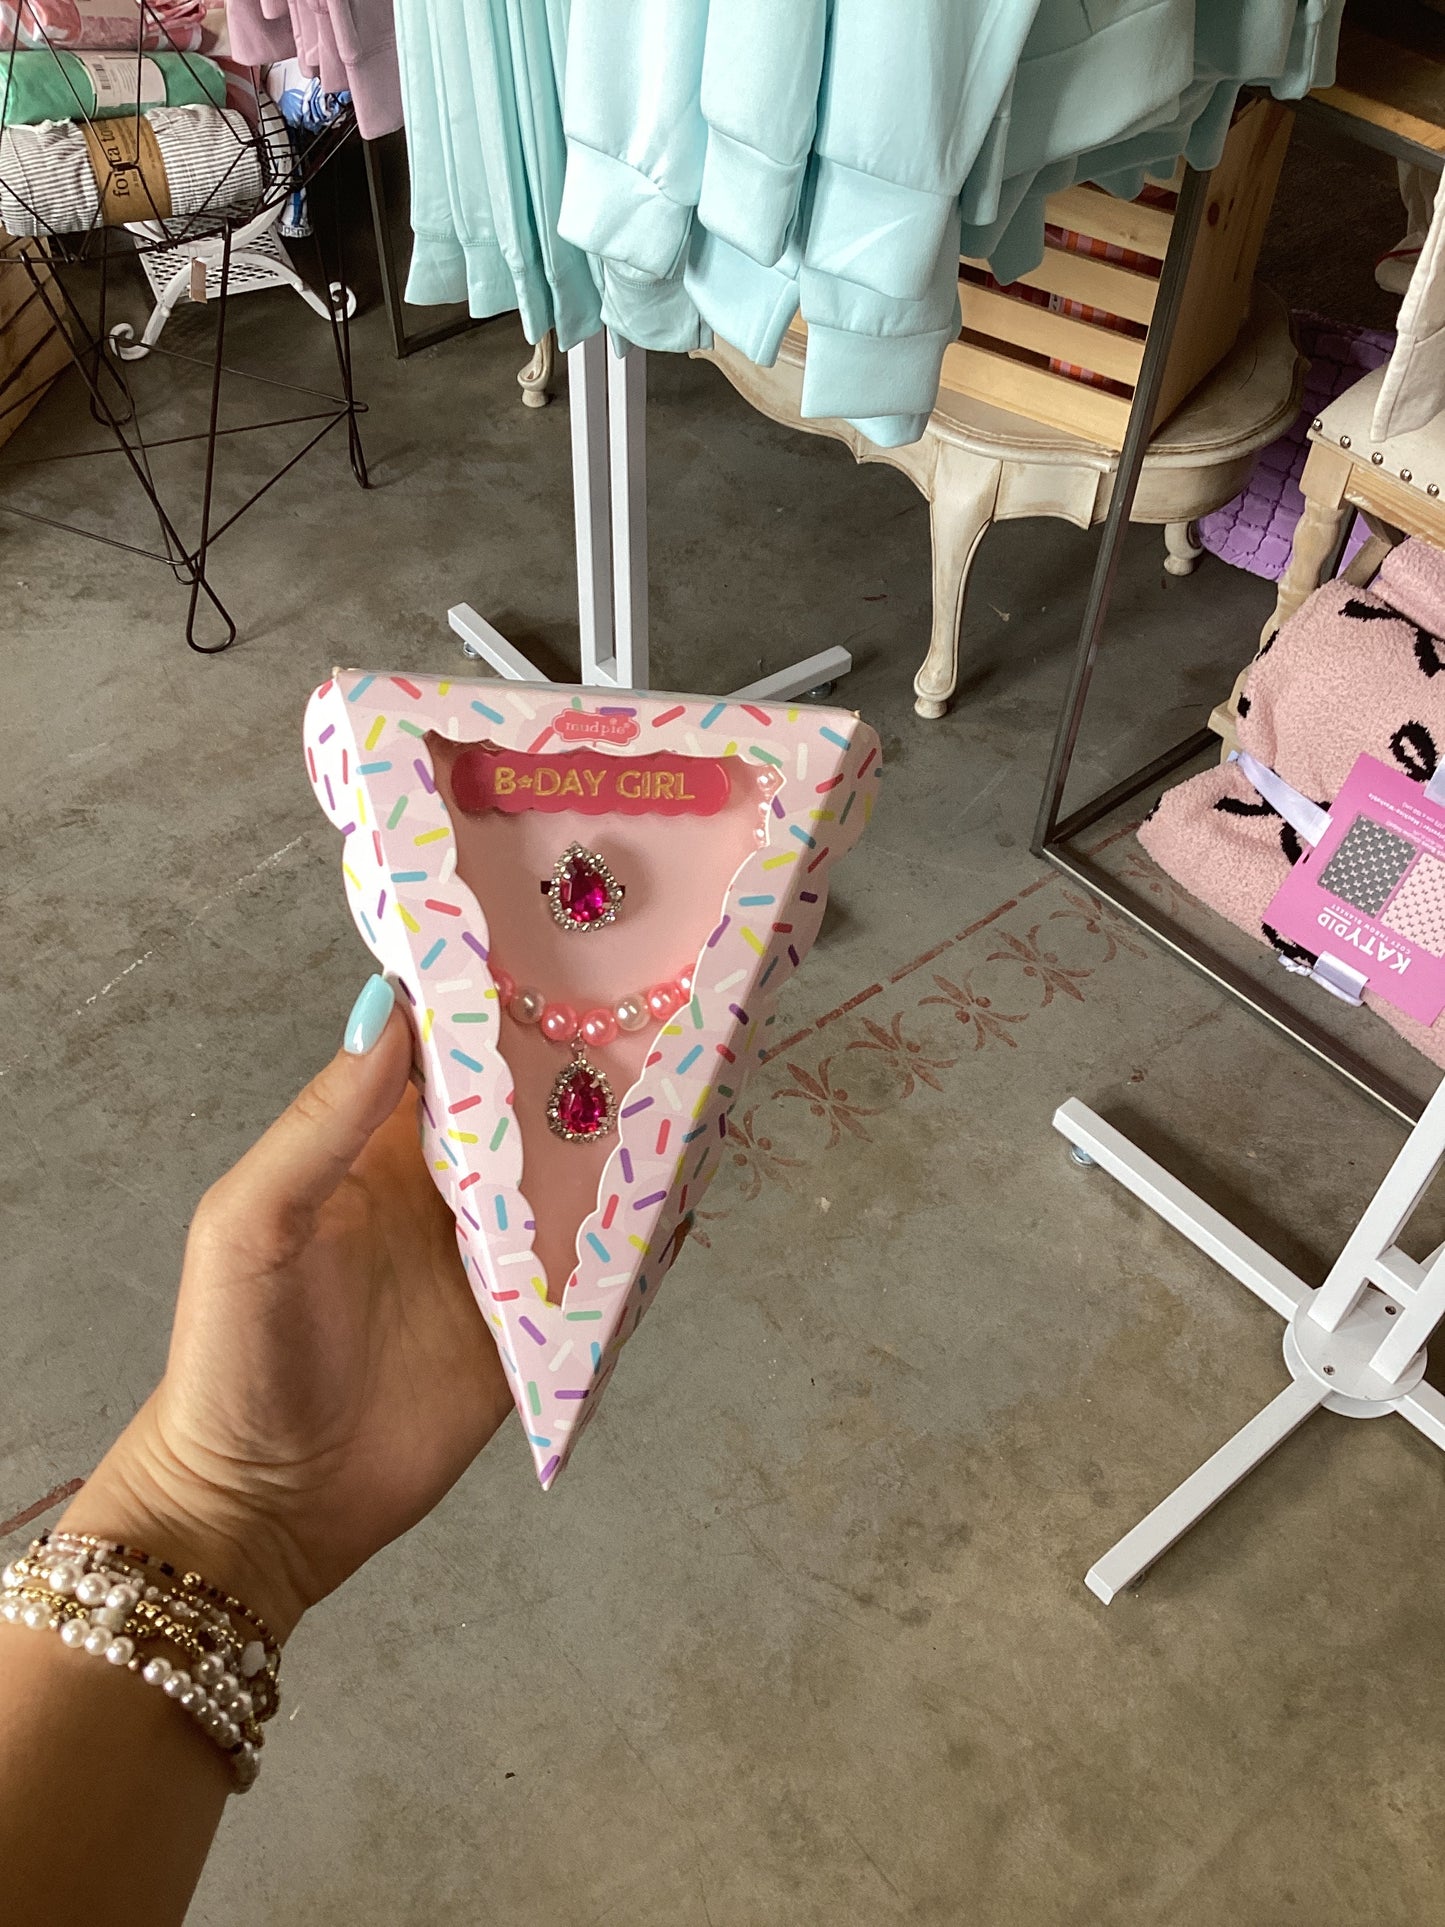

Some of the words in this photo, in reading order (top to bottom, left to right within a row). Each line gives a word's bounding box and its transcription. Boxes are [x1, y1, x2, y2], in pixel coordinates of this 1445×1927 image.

[616, 769, 696, 801] GIRL
[1331, 904, 1363, 925] BLANKET
[1317, 910, 1412, 975] KATYDID
[1364, 923, 1389, 942] THROW
[1391, 940, 1411, 955] COZY
